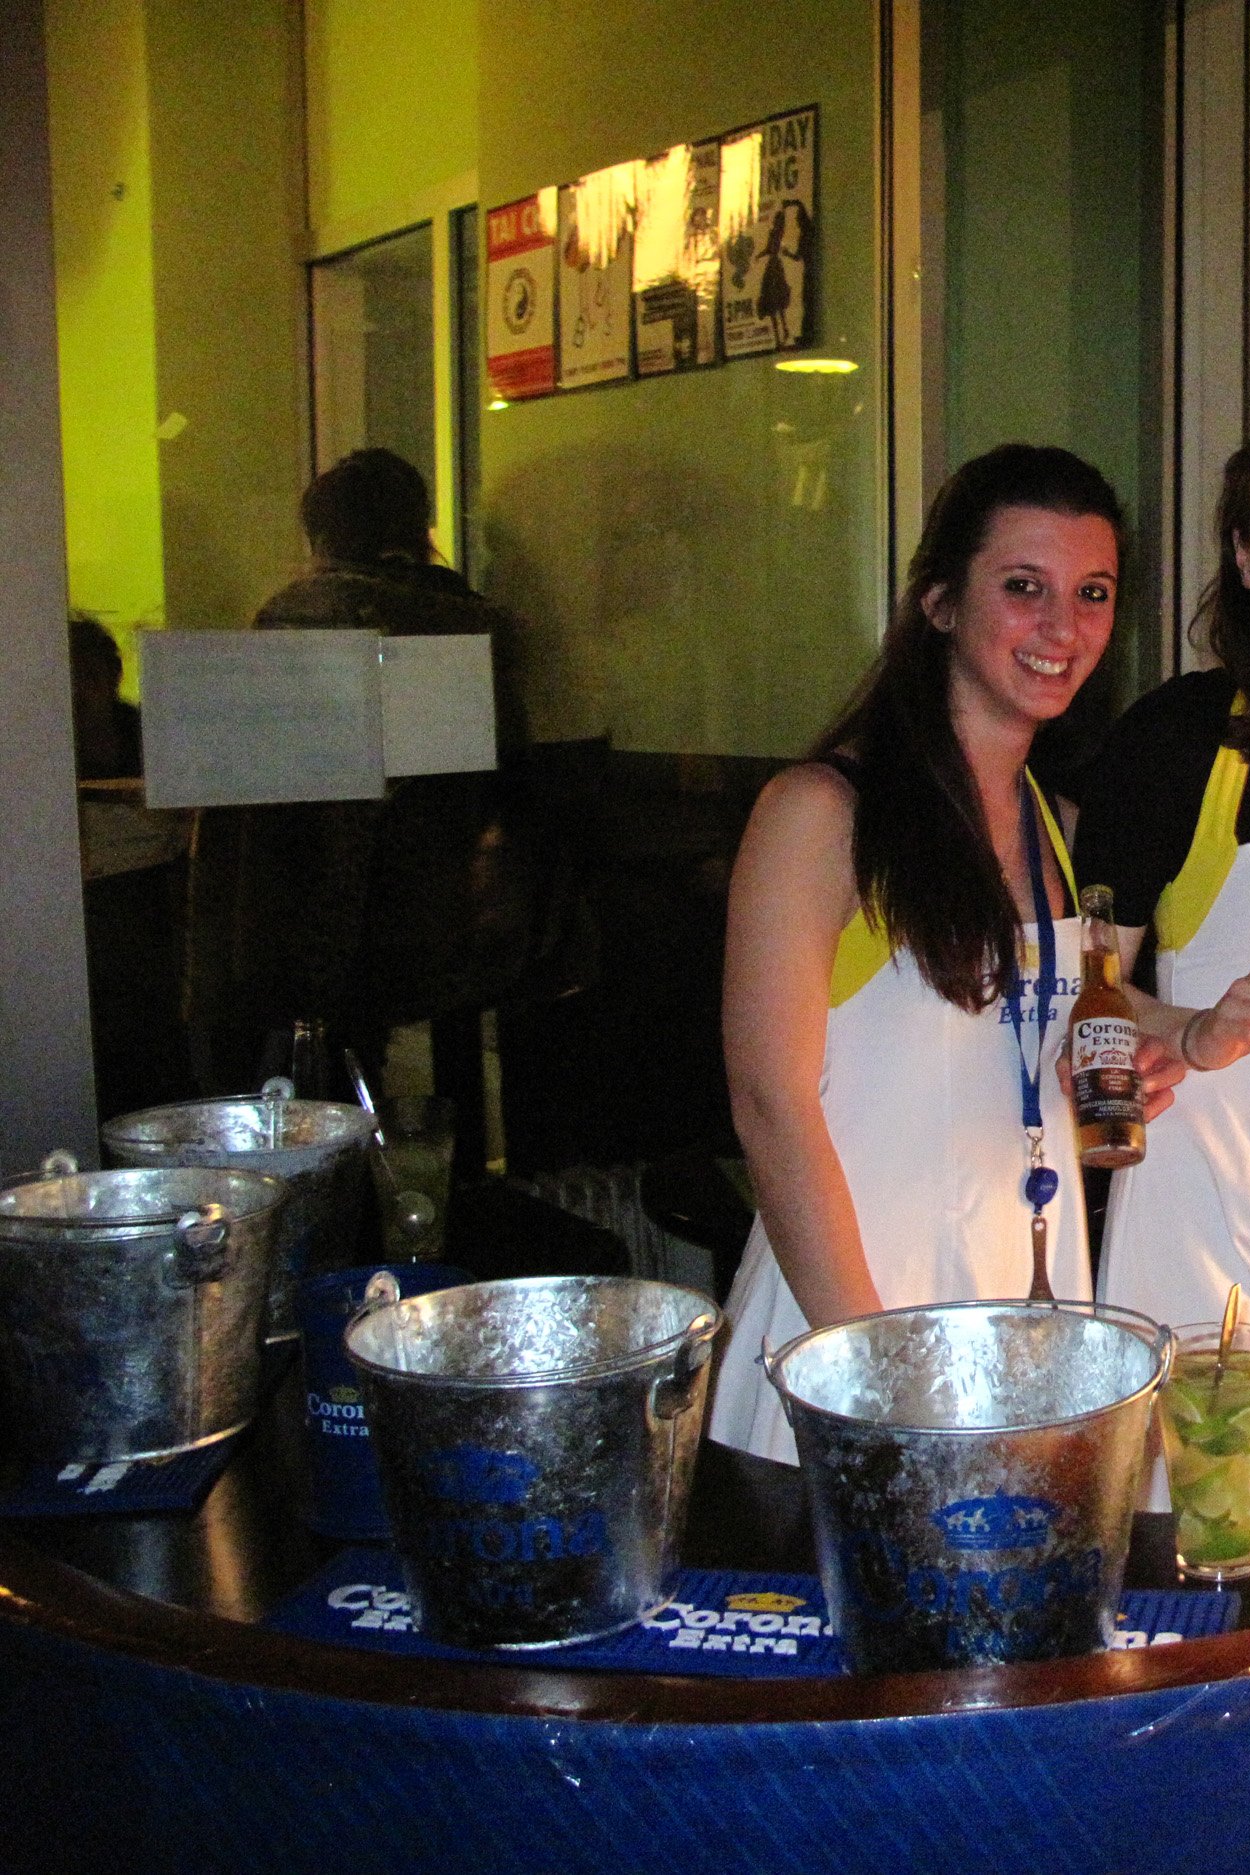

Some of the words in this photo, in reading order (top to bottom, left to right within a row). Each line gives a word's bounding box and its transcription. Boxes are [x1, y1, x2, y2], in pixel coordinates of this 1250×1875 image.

[1078, 1022, 1138, 1039] Corona
[1092, 1036, 1130, 1046] Extra
[322, 1419, 370, 1437] Extra
[669, 1628, 798, 1655] Extra
